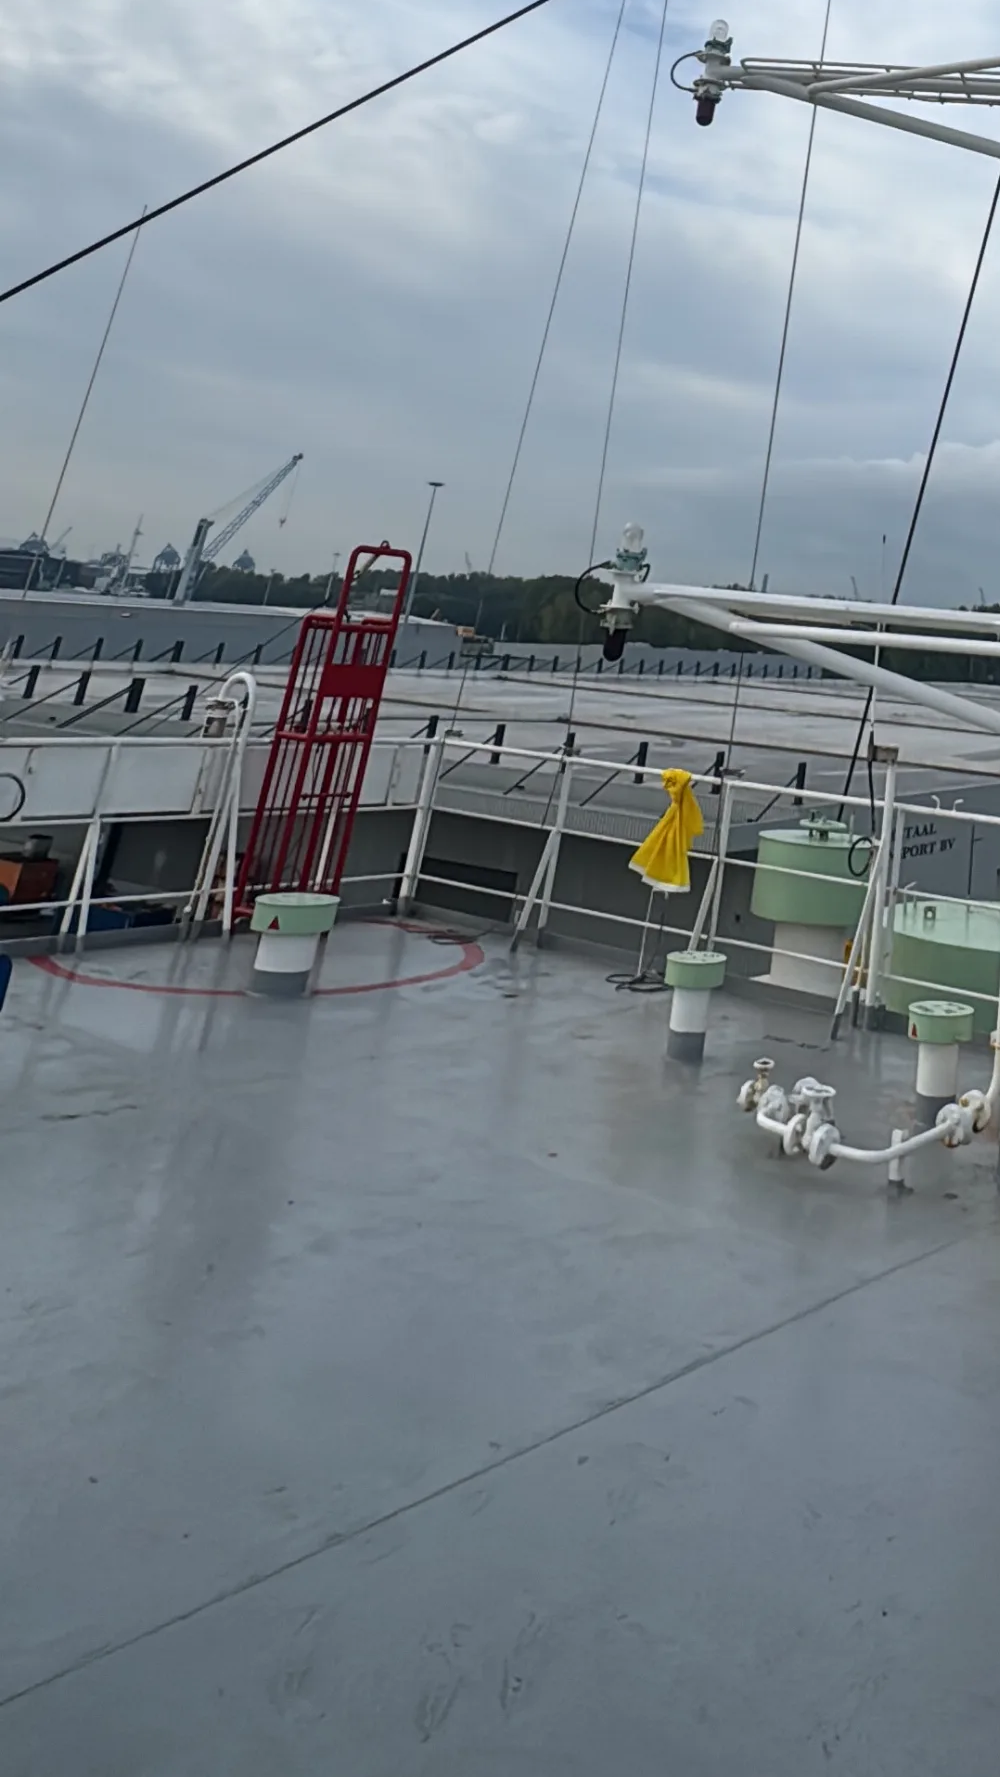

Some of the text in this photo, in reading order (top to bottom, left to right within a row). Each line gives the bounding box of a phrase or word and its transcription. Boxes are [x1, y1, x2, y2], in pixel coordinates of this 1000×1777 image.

[901, 823, 937, 839] TAAL
[899, 837, 956, 860] PORT BV
